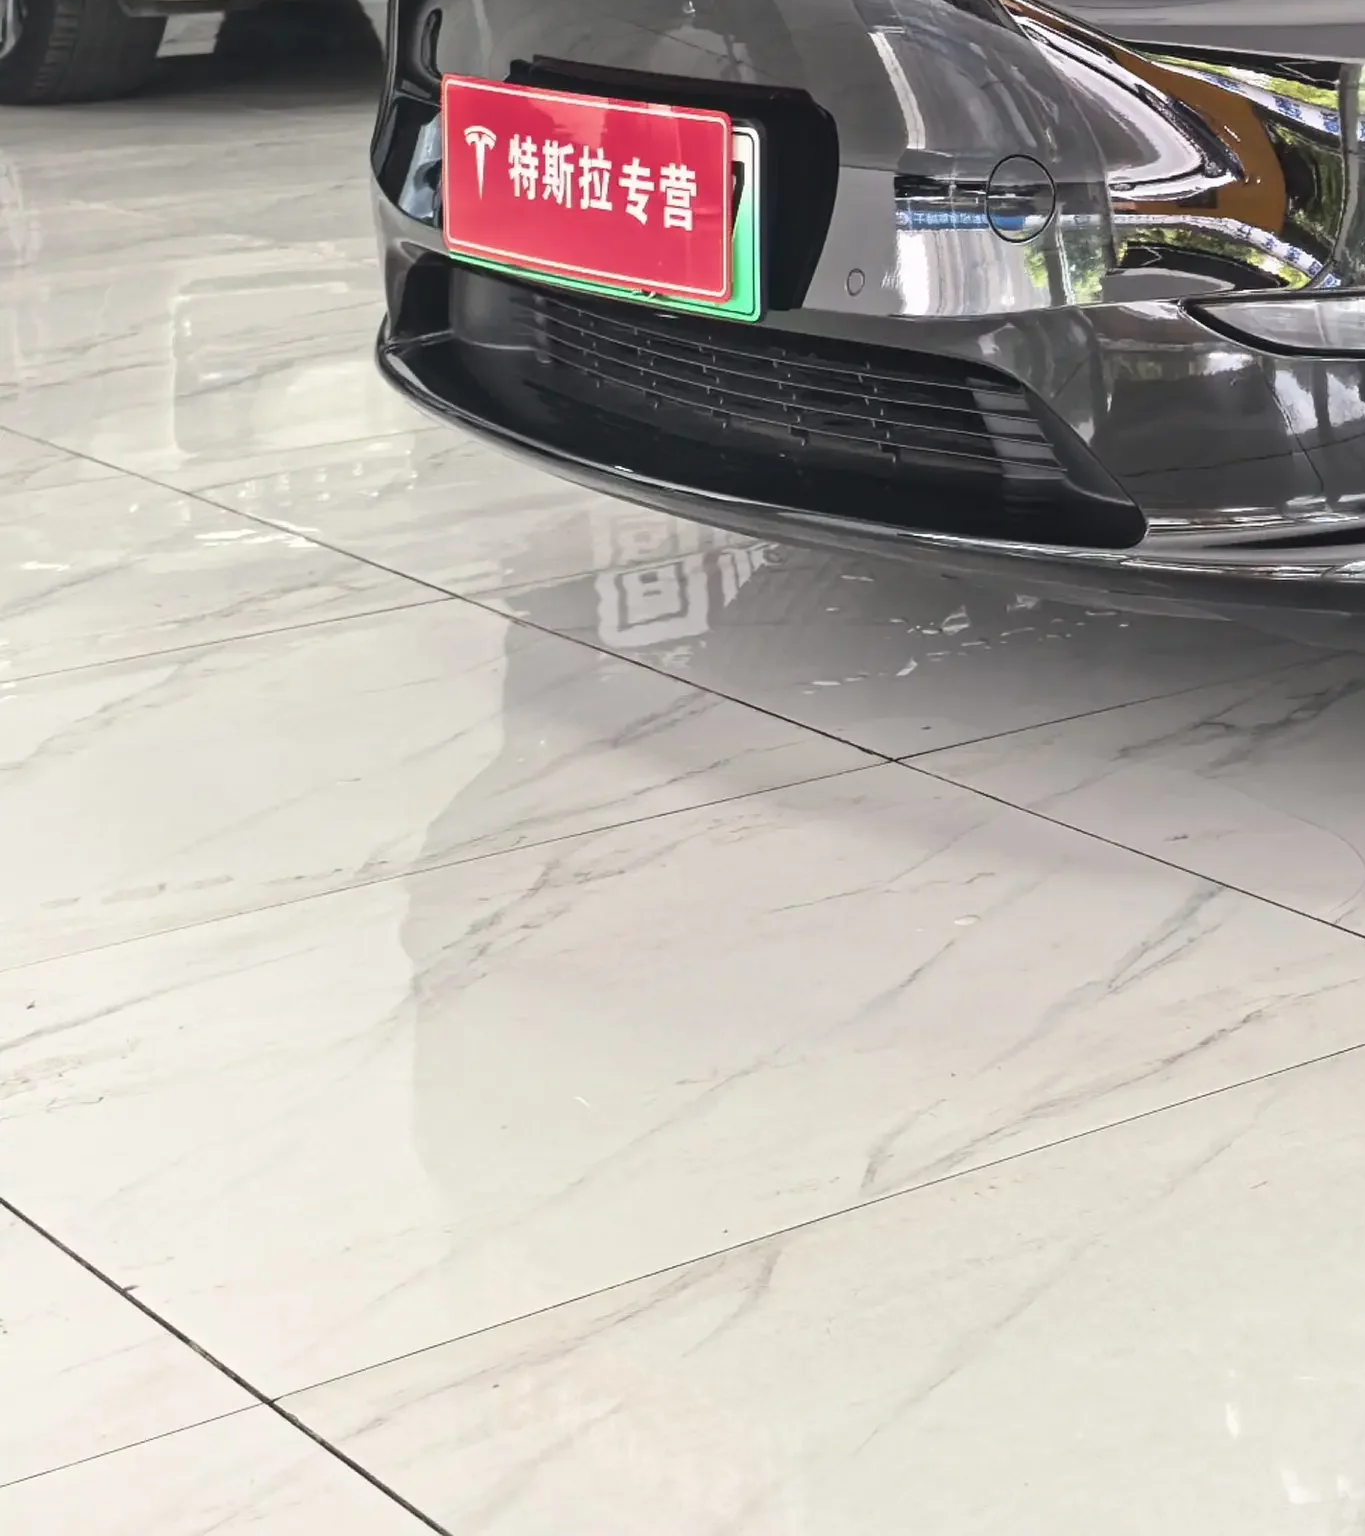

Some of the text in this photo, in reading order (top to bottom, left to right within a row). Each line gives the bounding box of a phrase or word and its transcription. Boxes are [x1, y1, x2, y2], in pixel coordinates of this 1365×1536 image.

[508, 133, 698, 232] 特斯拉专营
